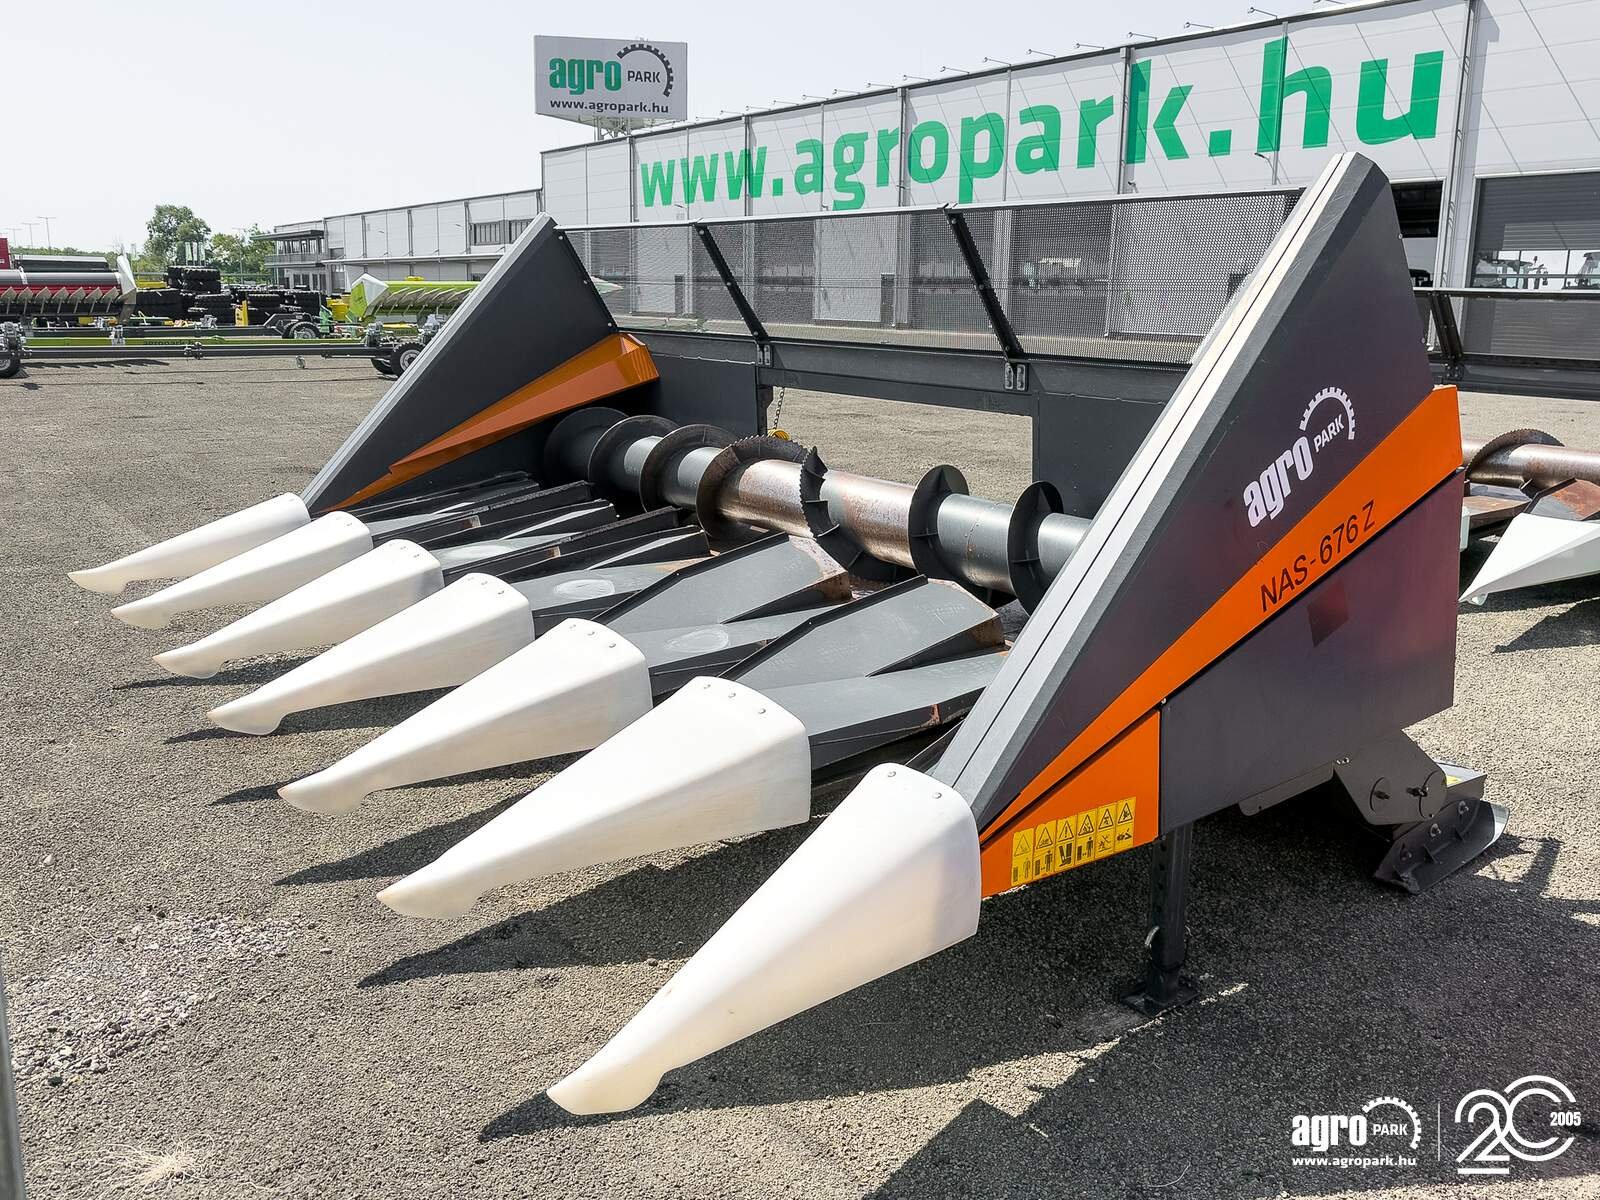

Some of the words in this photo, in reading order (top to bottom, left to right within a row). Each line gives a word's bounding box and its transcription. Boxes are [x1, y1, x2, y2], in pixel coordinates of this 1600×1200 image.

[549, 58, 622, 96] agro
[627, 70, 661, 84] PARK
[550, 99, 669, 114] www.agropark.hu
[640, 36, 1444, 212] www.agropark.hu
[1243, 436, 1314, 528] agro
[1313, 414, 1344, 452] PARK
